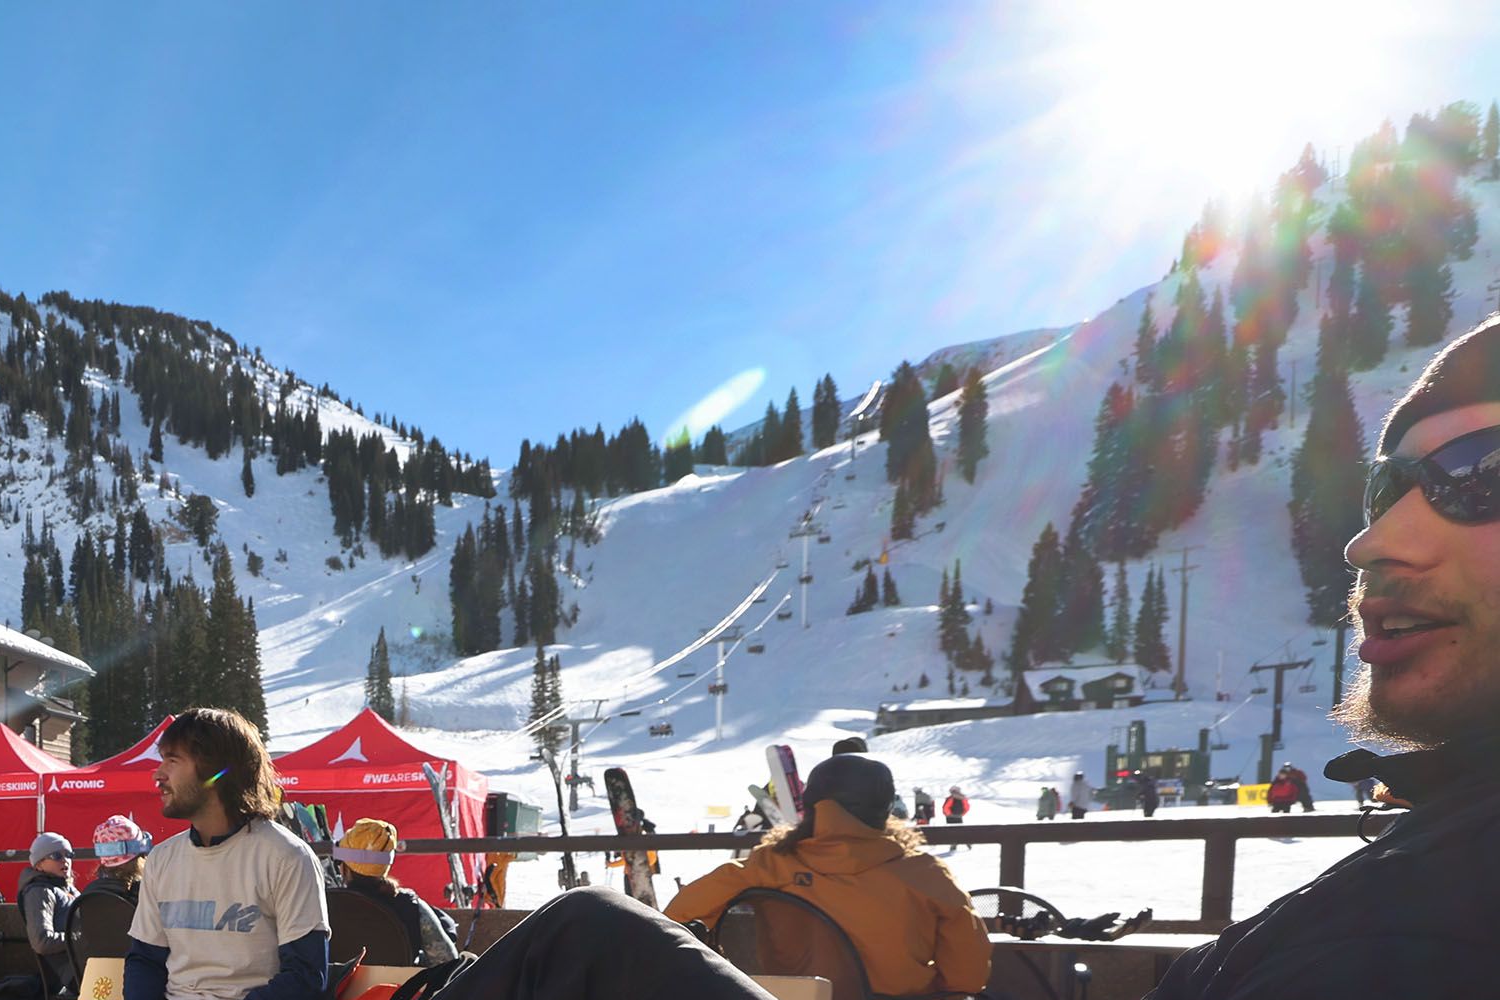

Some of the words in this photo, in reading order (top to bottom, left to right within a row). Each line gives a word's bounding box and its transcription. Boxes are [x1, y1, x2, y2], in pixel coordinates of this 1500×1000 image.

[60, 779, 105, 789] ATOMIC
[274, 776, 299, 785] MIC
[214, 902, 261, 932] K2
